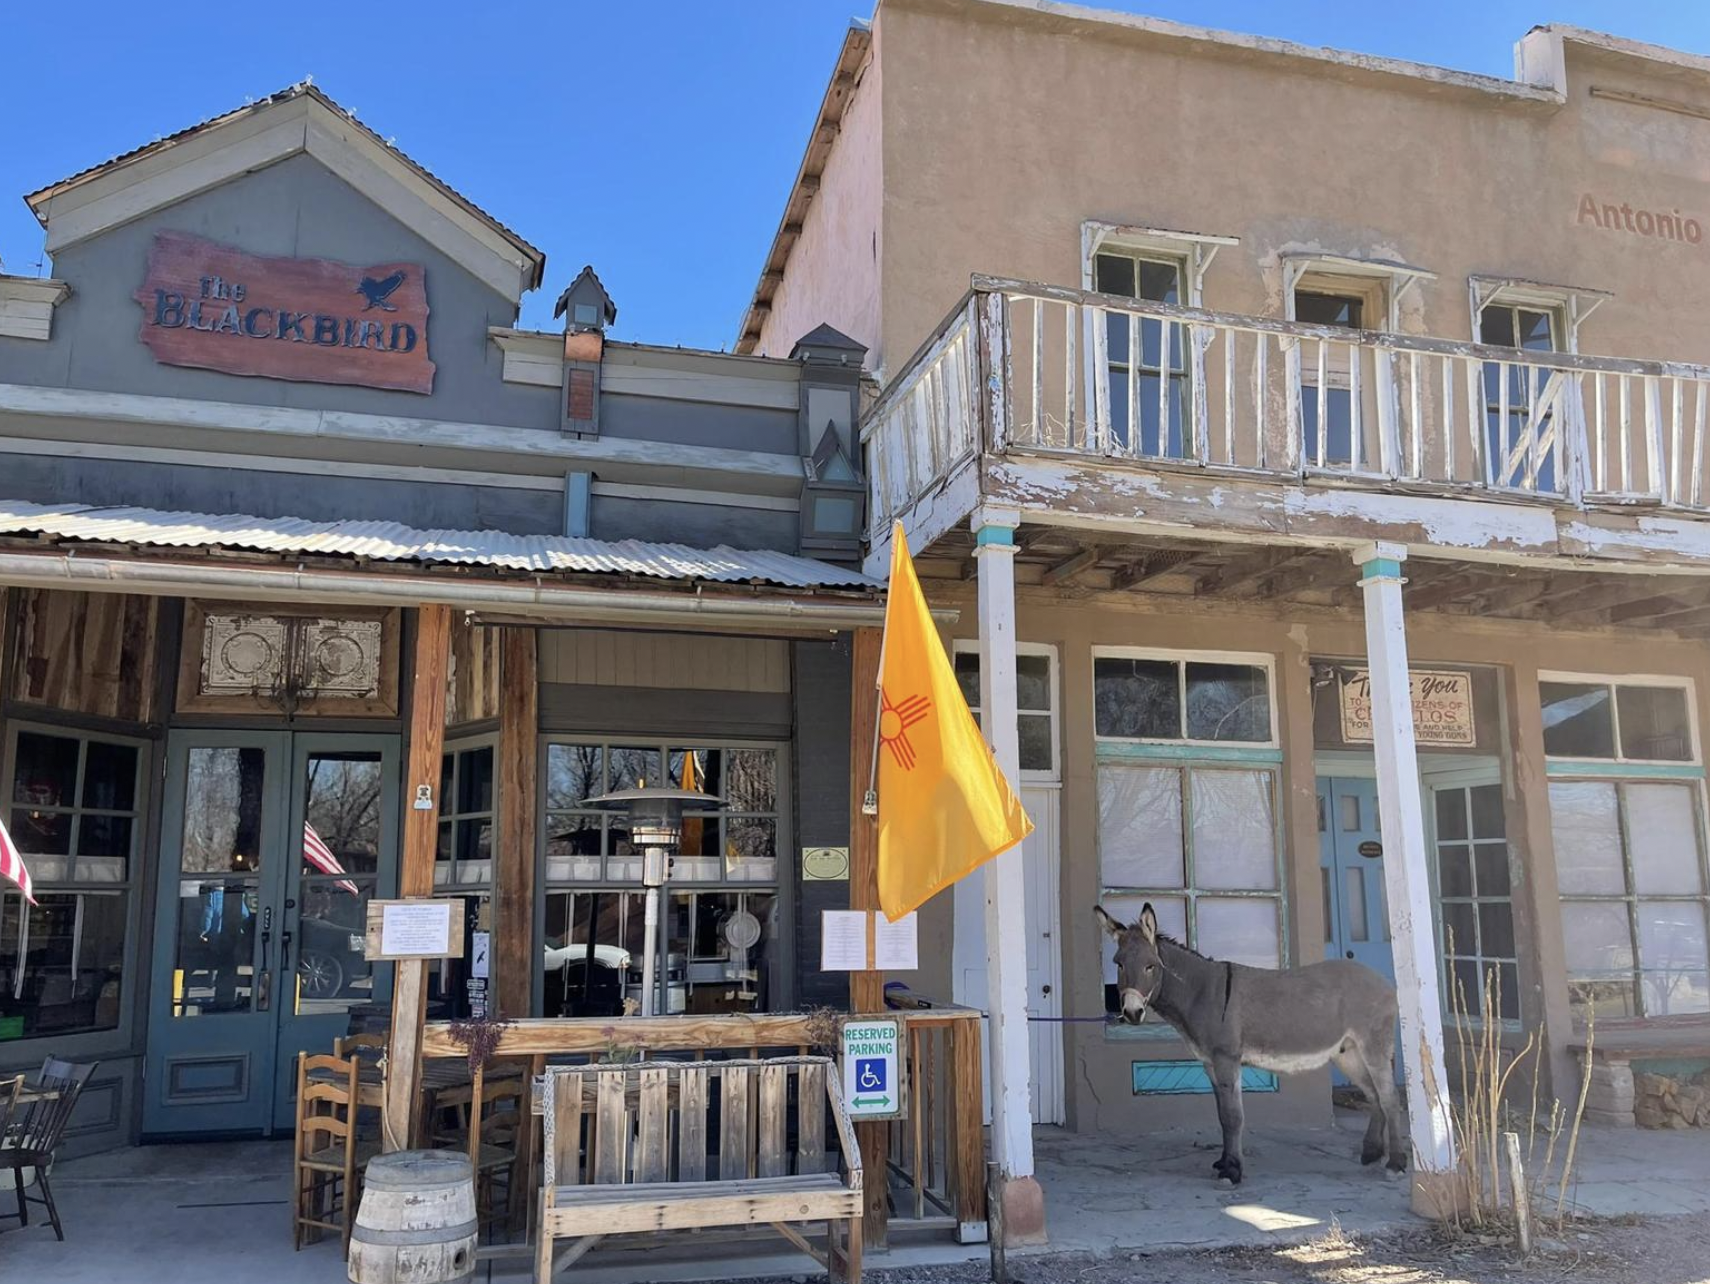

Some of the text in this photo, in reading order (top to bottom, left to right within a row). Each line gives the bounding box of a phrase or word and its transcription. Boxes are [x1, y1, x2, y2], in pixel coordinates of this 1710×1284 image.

[1577, 193, 1702, 244] Antonio
[199, 275, 246, 302] The
[151, 288, 418, 353] BLACKBIRD
[1420, 677, 1459, 700] You
[1350, 697, 1361, 706] TO
[1448, 701, 1463, 710] OF
[1417, 730, 1444, 739] YOUNG
[845, 1027, 896, 1041] RESERVED
[848, 1043, 893, 1055] PARKING
